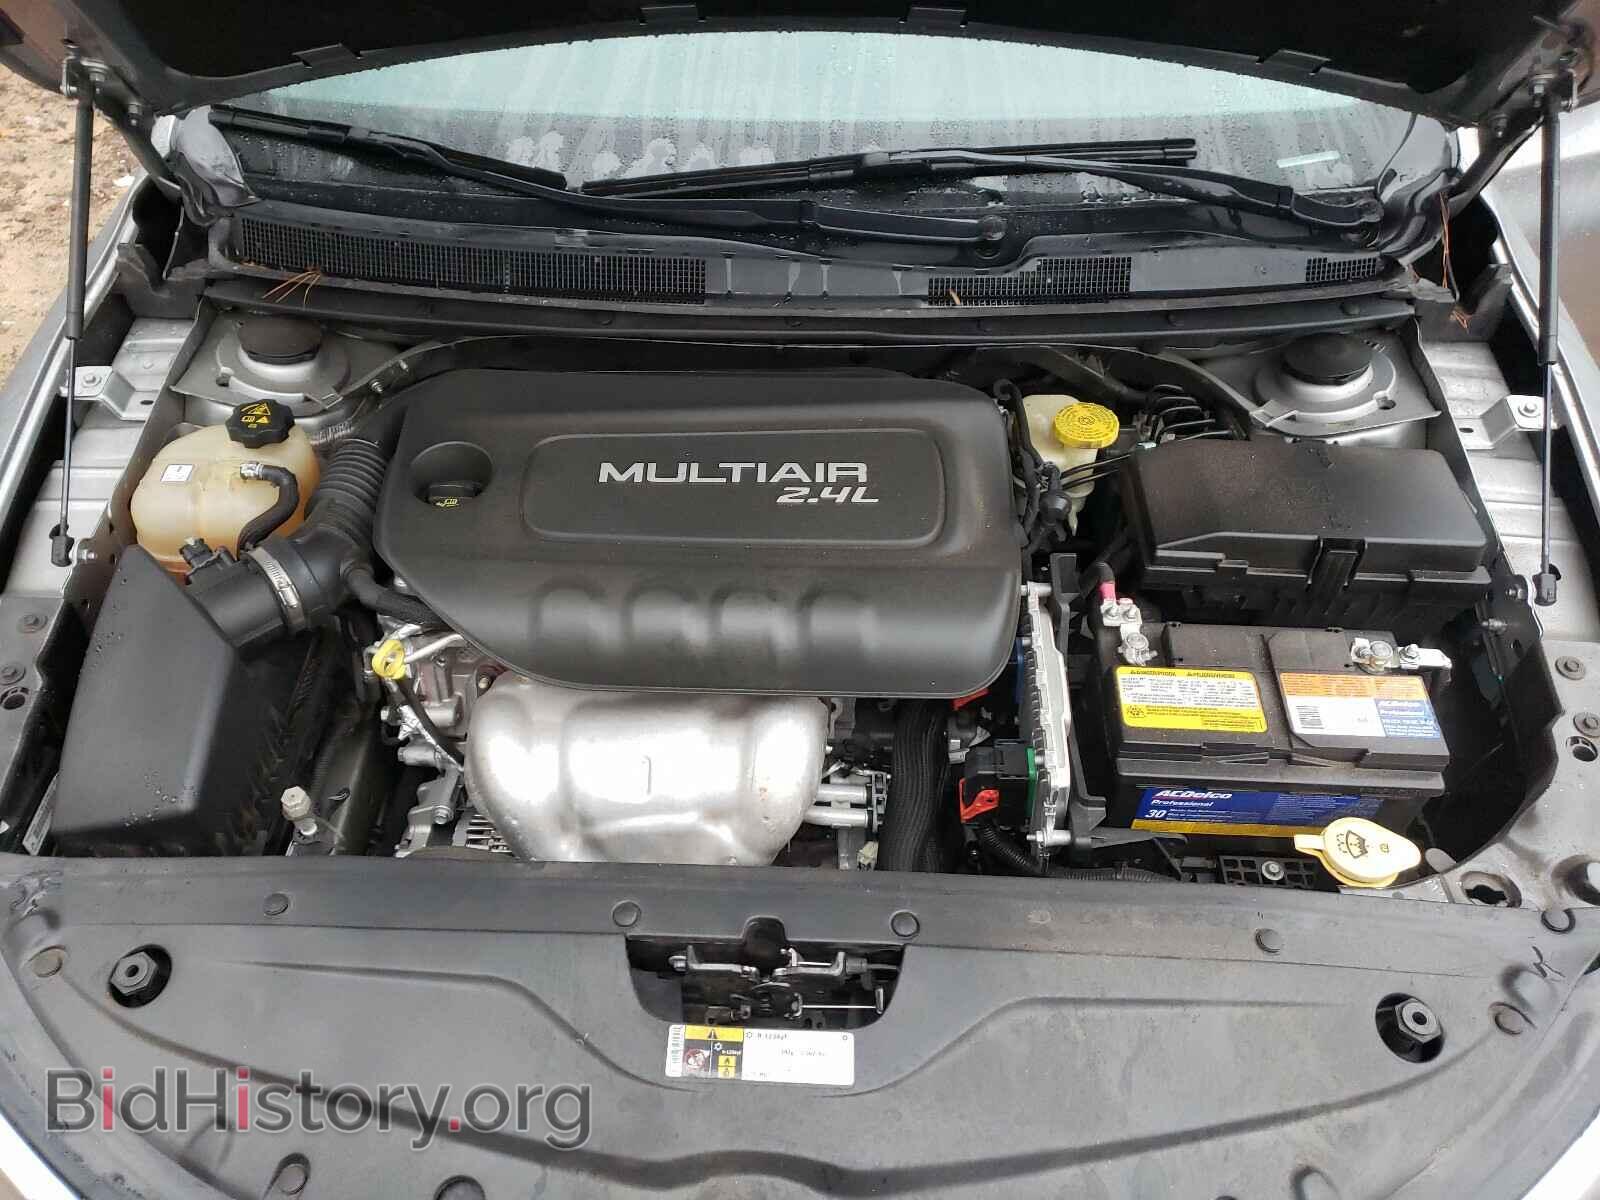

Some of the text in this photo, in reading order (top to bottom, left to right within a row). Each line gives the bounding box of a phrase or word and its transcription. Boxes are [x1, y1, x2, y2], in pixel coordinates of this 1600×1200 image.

[598, 462, 868, 483] MULTIAIR
[776, 487, 880, 503] 2.4L
[1155, 790, 1232, 799] ACDelco
[1151, 799, 1214, 807] Professional
[1145, 809, 1167, 818] 30
